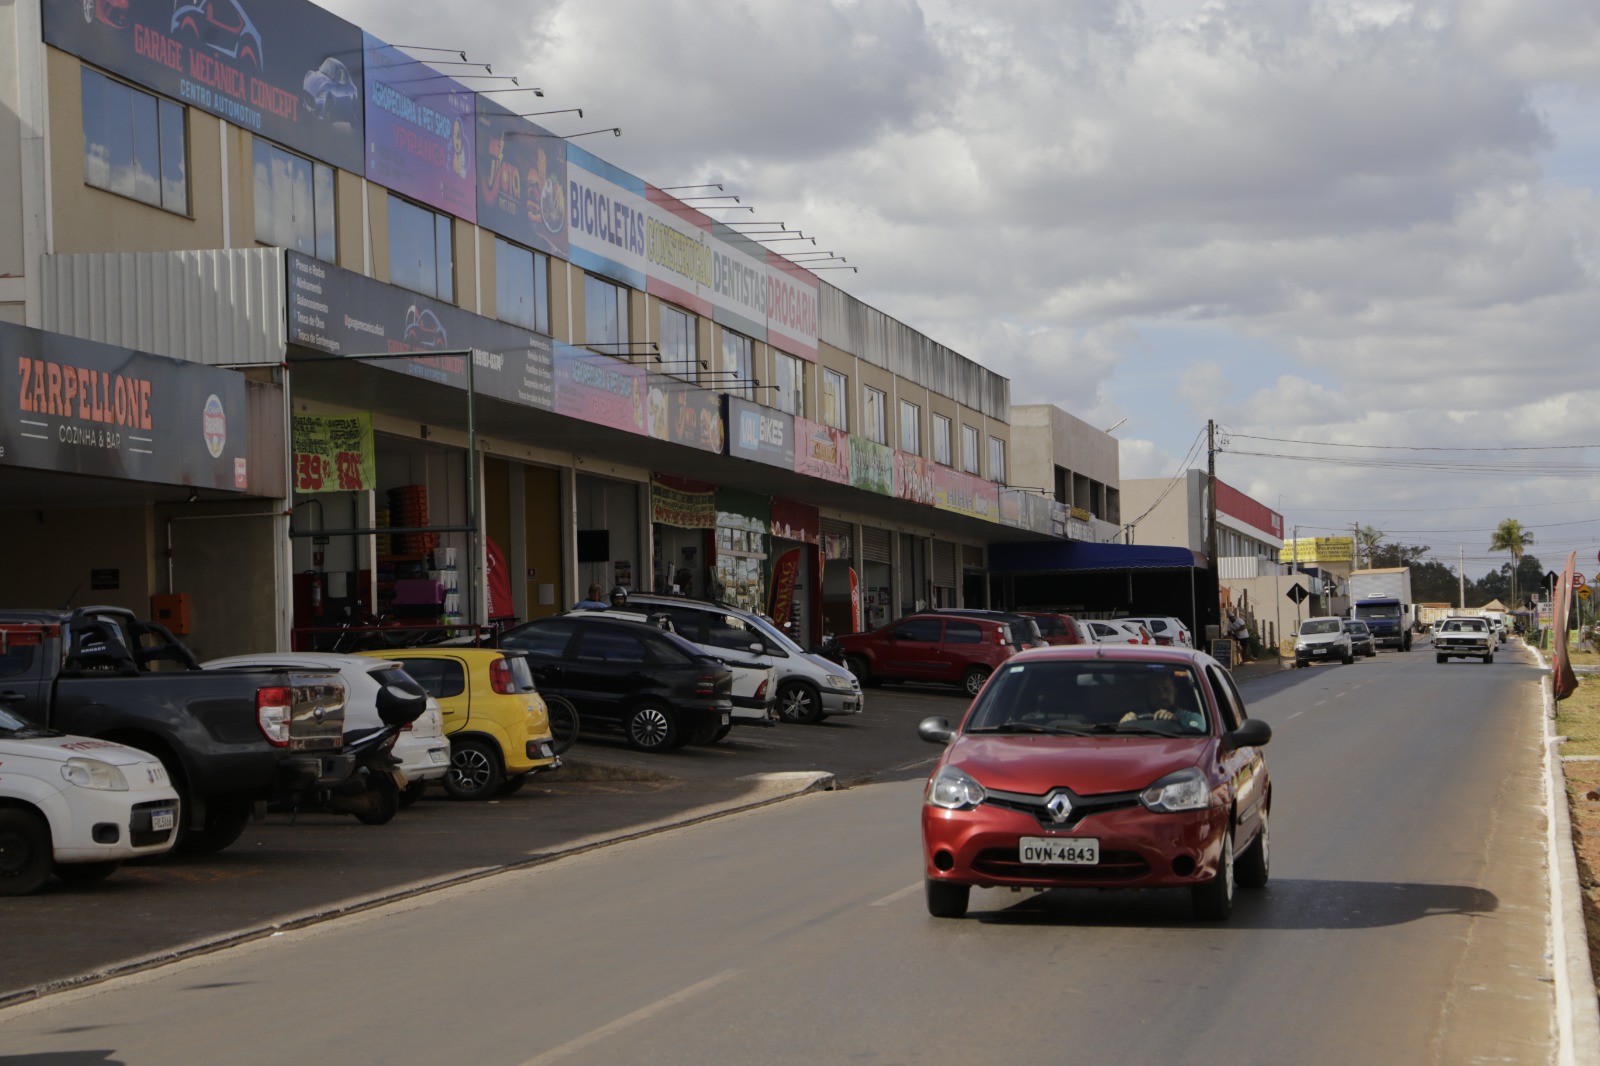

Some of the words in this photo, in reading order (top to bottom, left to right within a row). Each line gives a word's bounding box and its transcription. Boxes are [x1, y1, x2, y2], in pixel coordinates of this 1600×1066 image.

[134, 23, 183, 73] GARAGE
[190, 48, 247, 98] MECÂNICA
[251, 78, 300, 123] CONCEPT
[180, 78, 212, 107] CENTRO
[213, 94, 262, 129] AUTOMOTIVO
[570, 180, 644, 257] BICICLETAS
[646, 216, 713, 295] CONSTRUÇÃO
[713, 252, 766, 314] DENTISTAS
[767, 274, 817, 337] DROGARIA
[18, 356, 152, 430] ZARPELLONE
[59, 424, 97, 448] COZINHA
[98, 431, 105, 448] &
[106, 432, 121, 450] BAR
[741, 415, 759, 446] VAL
